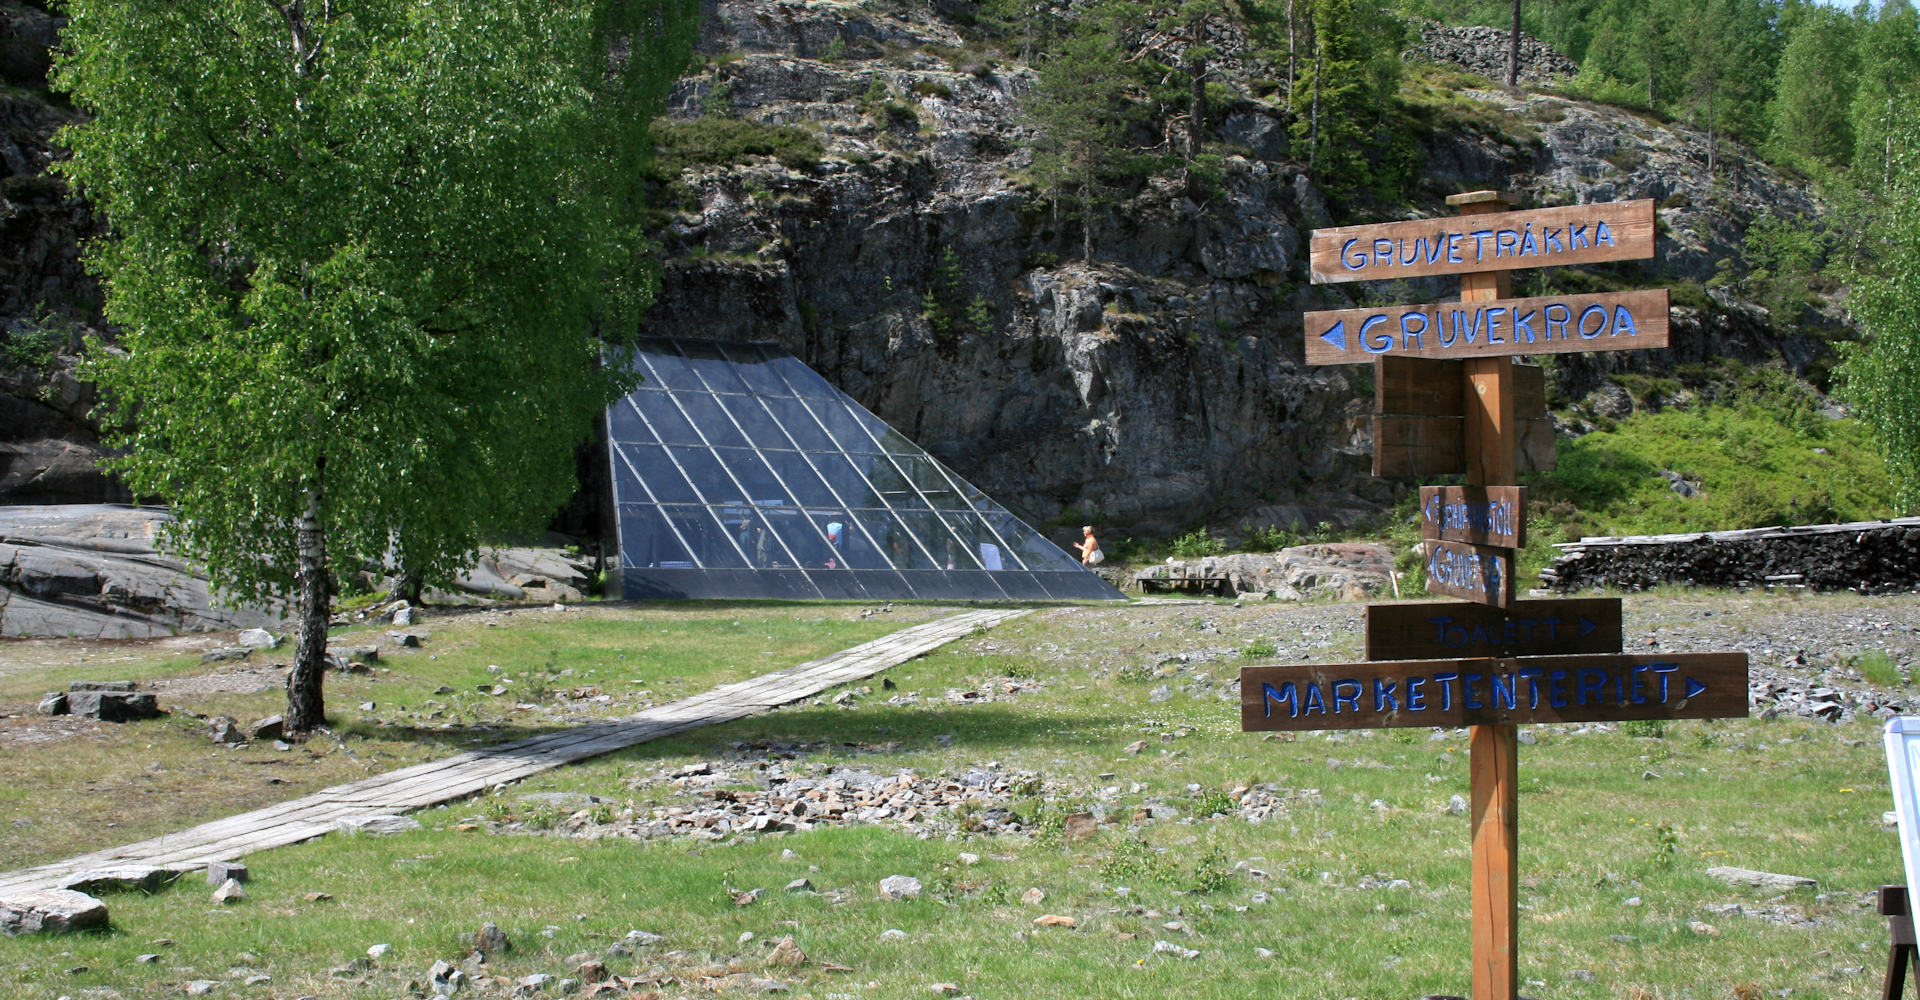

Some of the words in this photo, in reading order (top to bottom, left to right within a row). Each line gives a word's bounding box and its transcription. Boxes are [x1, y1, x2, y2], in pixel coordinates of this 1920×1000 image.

[1341, 220, 1615, 271] GRUVETRÅKKA
[1358, 303, 1637, 353] GRUVEKROA
[1428, 615, 1563, 648] TOALETT
